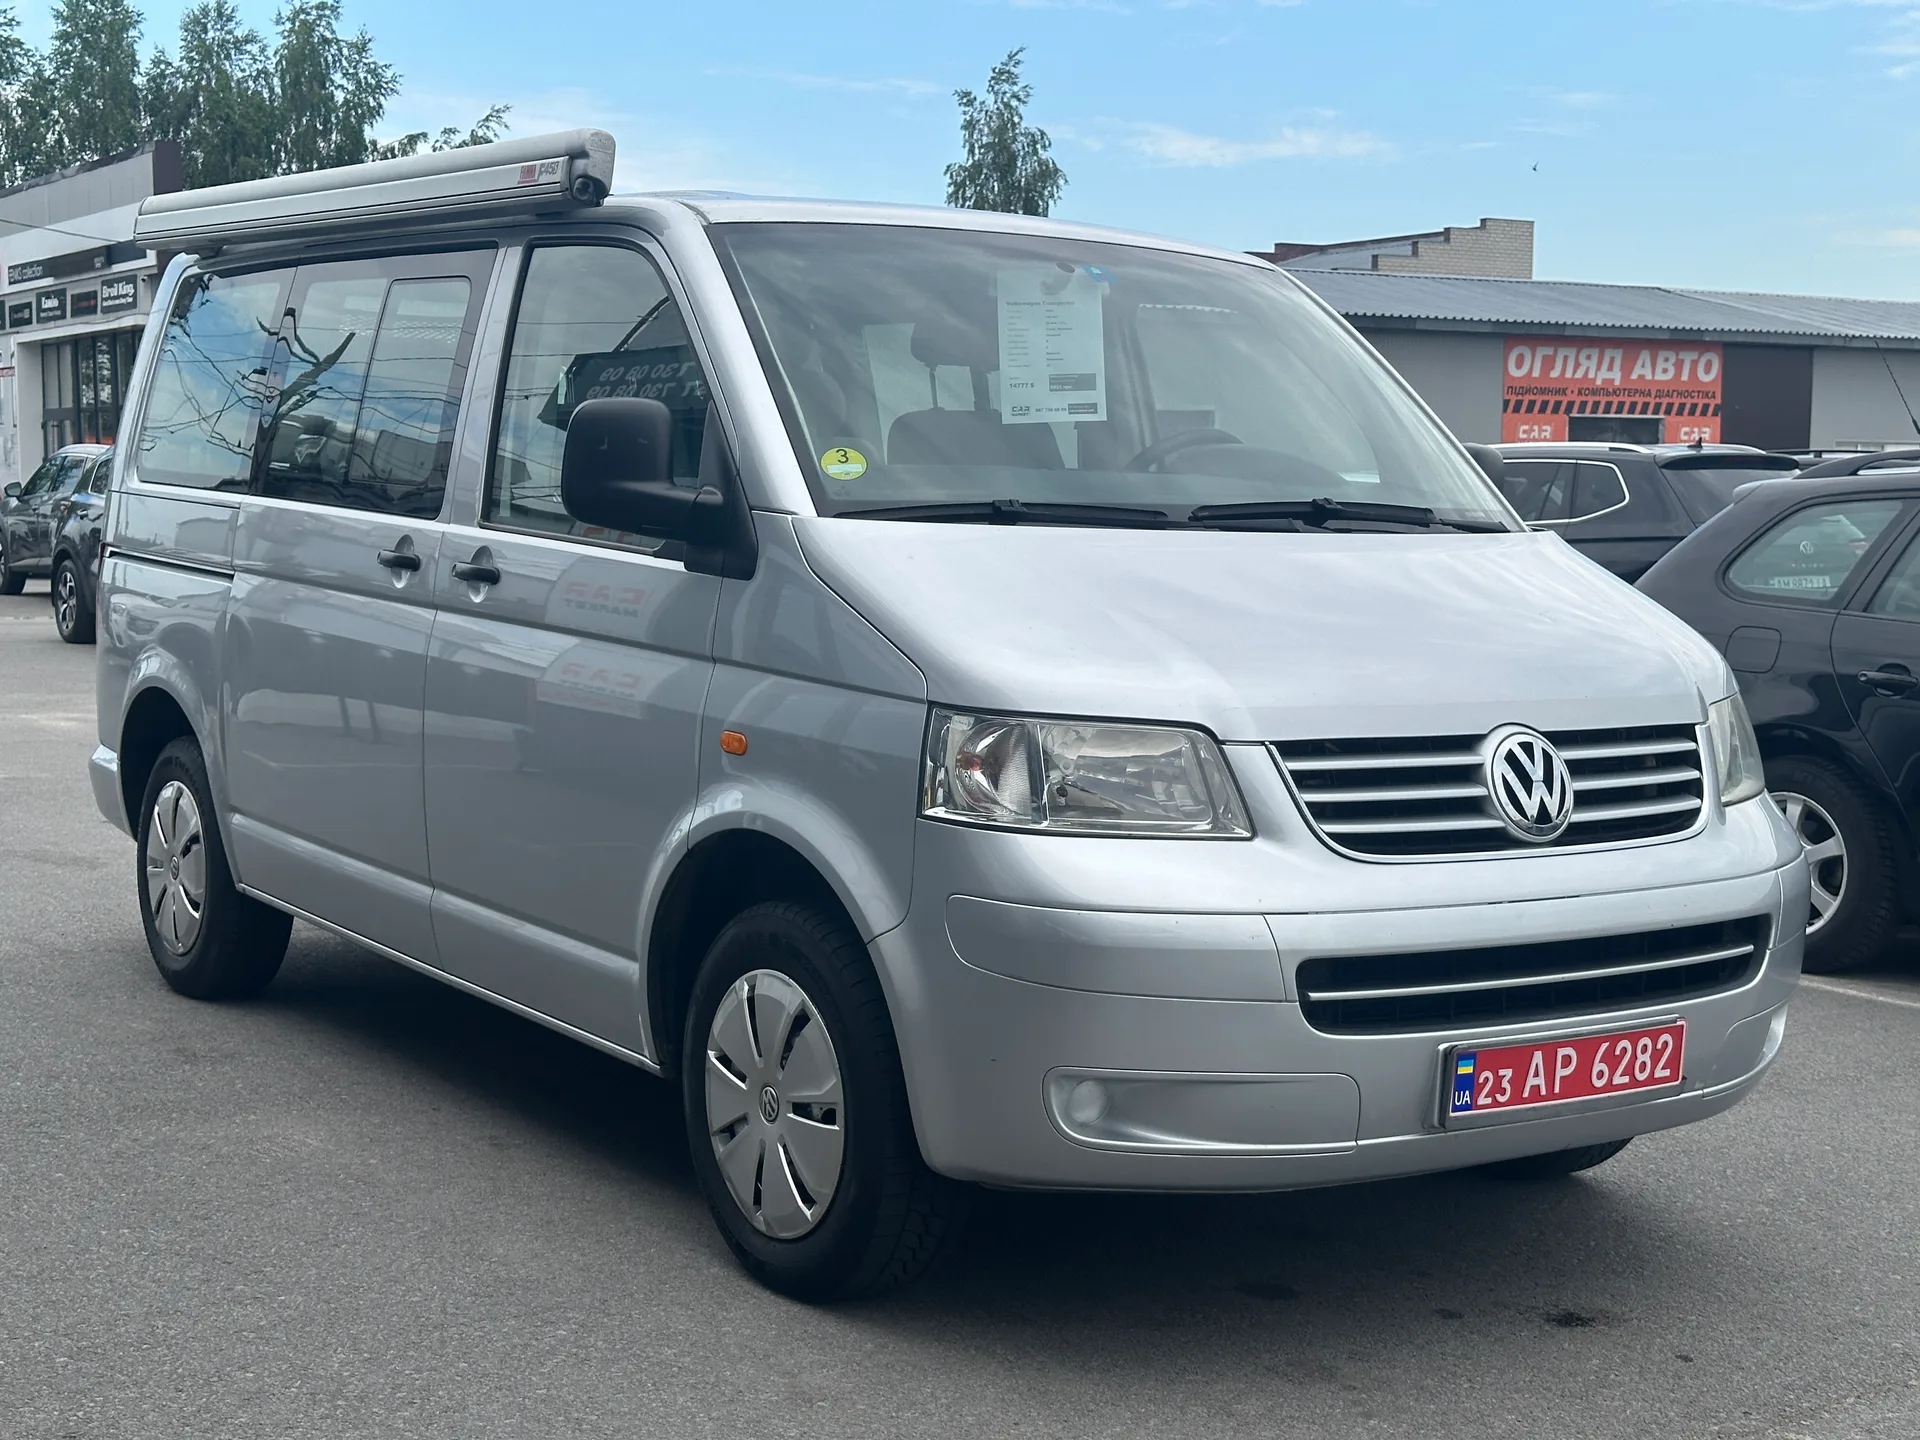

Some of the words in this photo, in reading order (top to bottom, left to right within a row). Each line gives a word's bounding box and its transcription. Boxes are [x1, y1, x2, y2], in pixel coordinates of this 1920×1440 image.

[1507, 344, 1622, 386] ОГЛЯД
[1629, 349, 1720, 383] АВТО
[1506, 384, 1568, 397] ПІДЙОМНИК
[1654, 387, 1717, 400] ДІАГНОСТІКА
[1518, 424, 1552, 439] CAR
[1680, 426, 1711, 441] CAR
[836, 449, 849, 464] 3
[1476, 1068, 1513, 1106] 23
[1522, 1047, 1577, 1098] AP
[1591, 1033, 1674, 1088] 6282
[1454, 1090, 1471, 1106] UA
